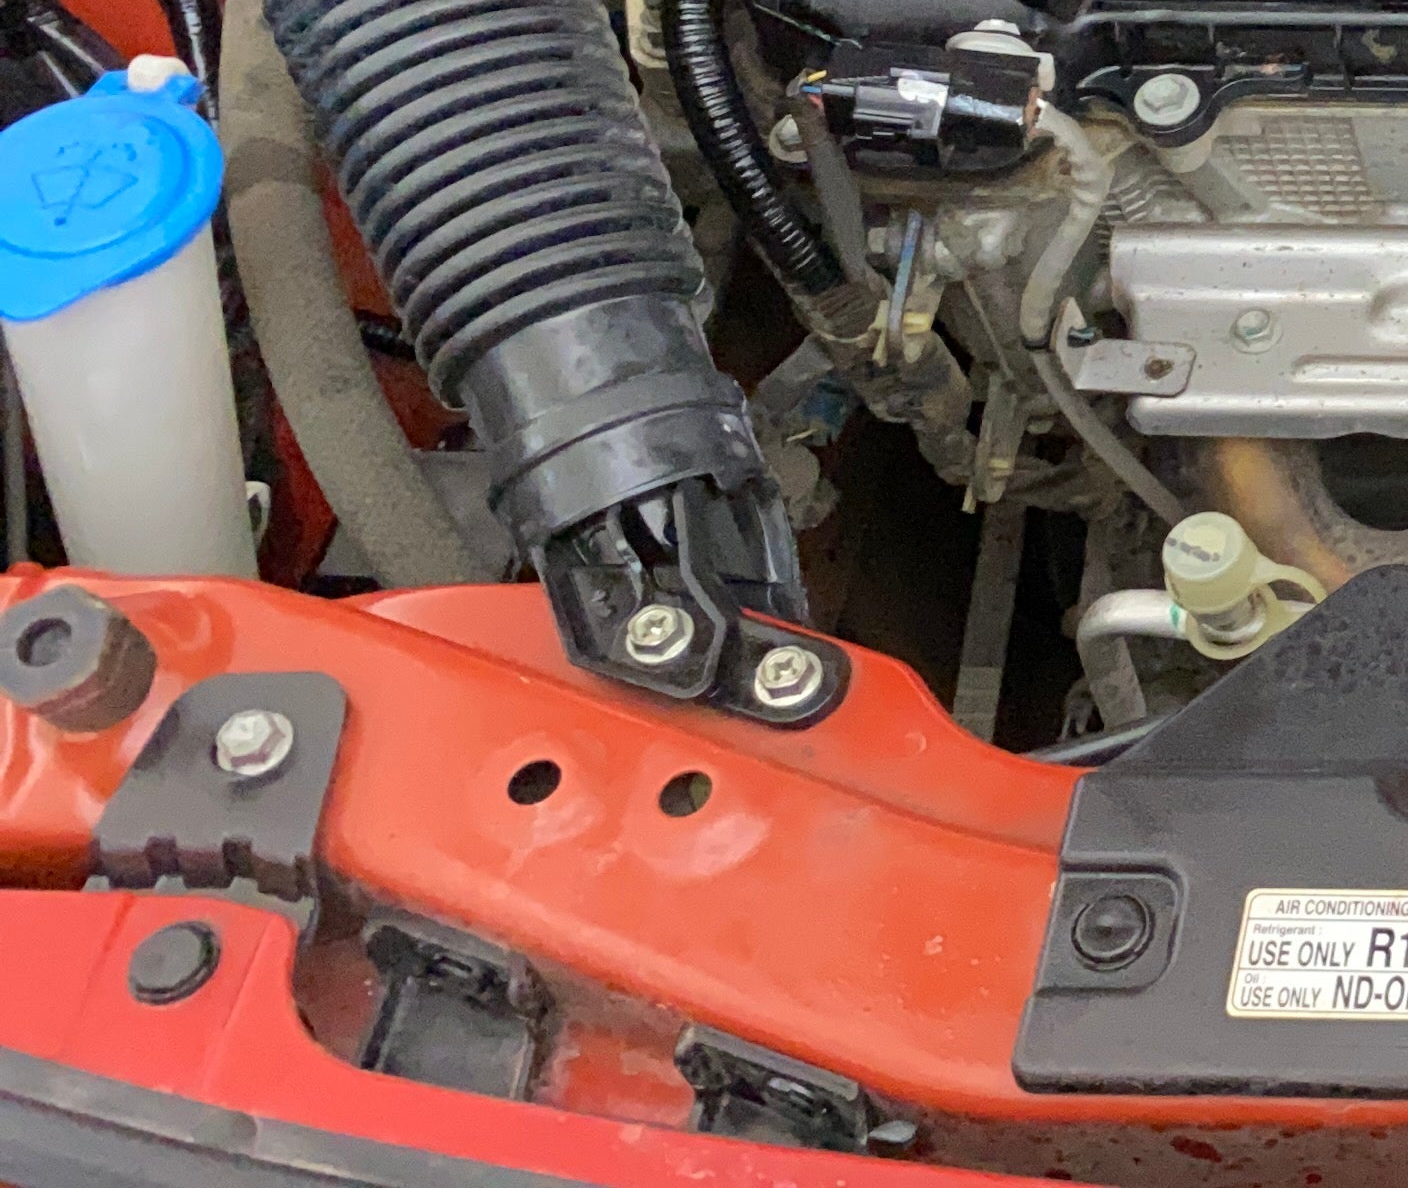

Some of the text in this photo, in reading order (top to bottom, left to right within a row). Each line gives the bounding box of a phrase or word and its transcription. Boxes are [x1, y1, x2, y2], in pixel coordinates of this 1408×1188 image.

[1275, 900, 1300, 914] AIR
[1253, 923, 1315, 937] Refrigerant
[1248, 940, 1291, 966] USE
[1298, 941, 1356, 967] ONLY
[1244, 973, 1259, 984] Oil
[1240, 986, 1273, 1007] USE
[1278, 987, 1321, 1008] ONLY
